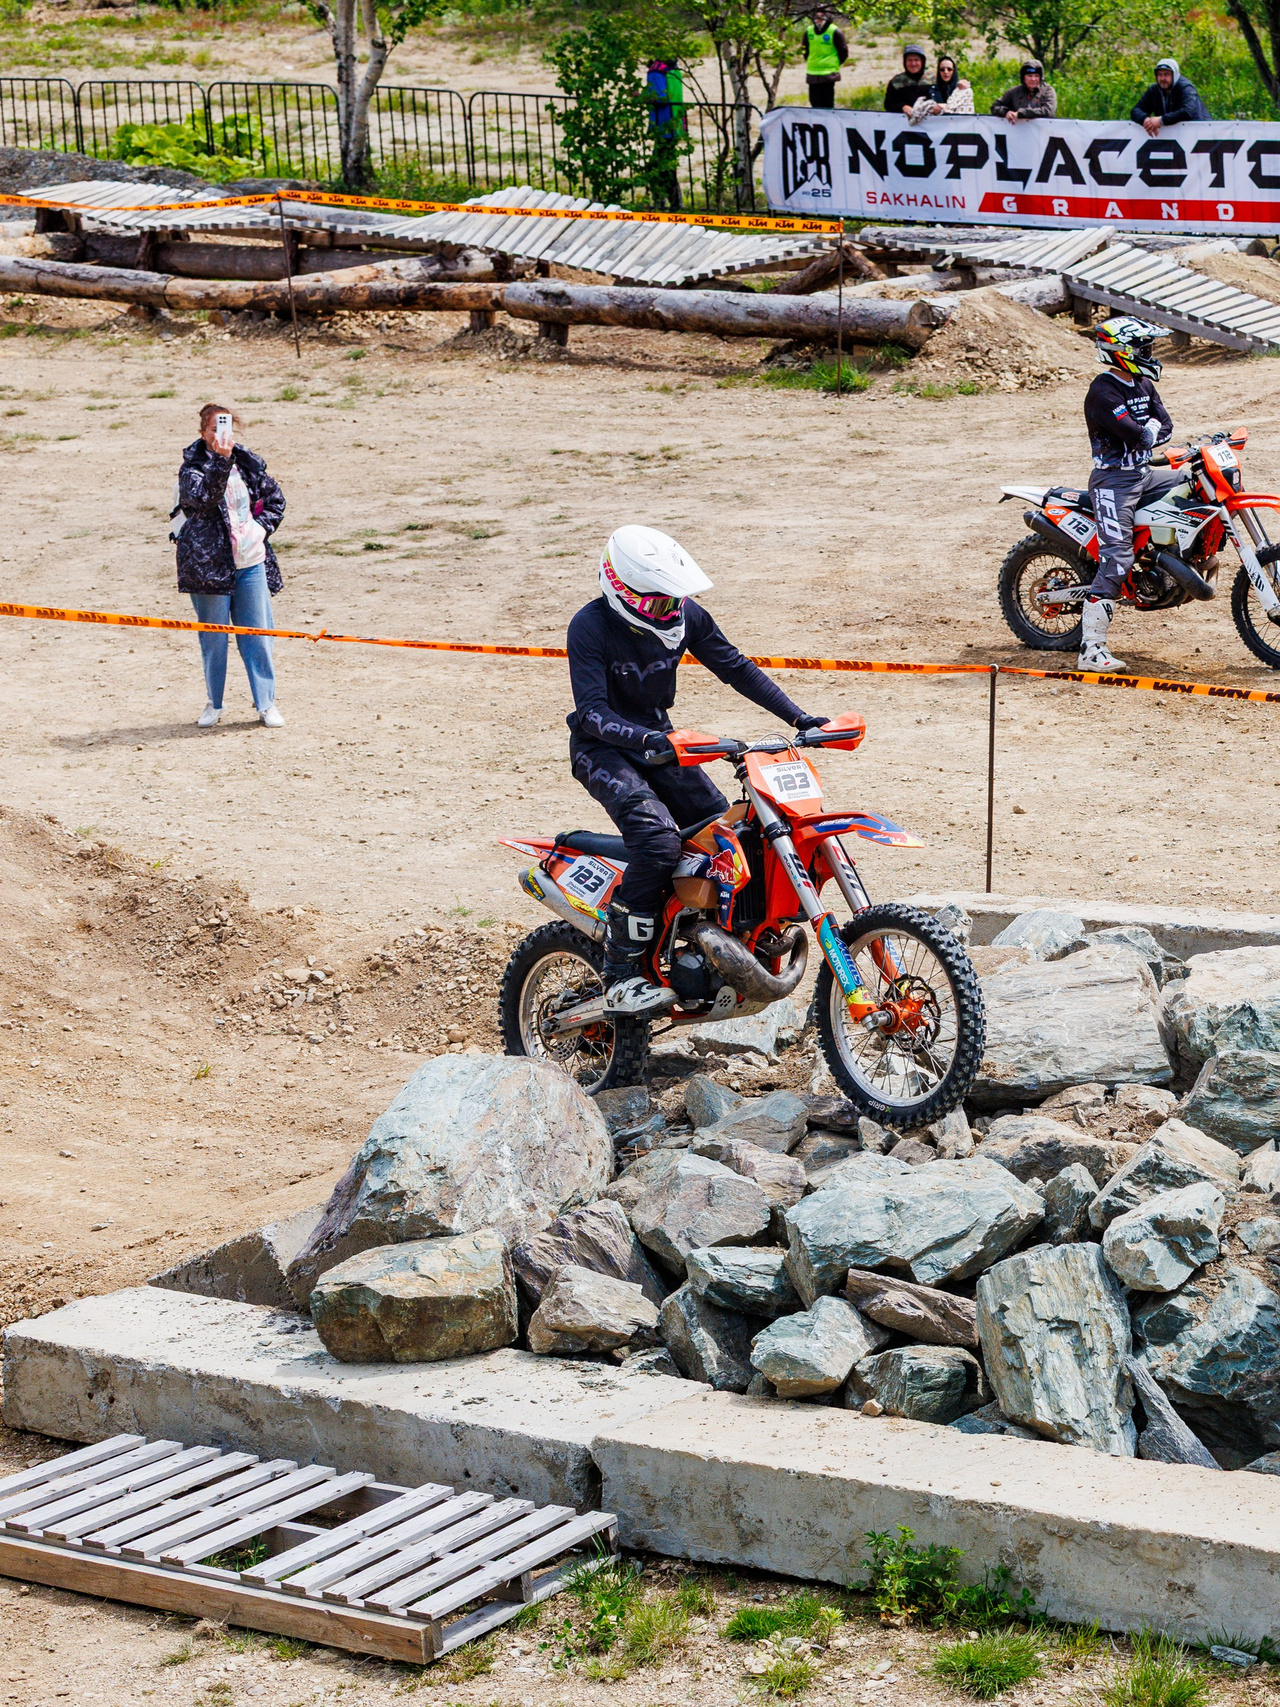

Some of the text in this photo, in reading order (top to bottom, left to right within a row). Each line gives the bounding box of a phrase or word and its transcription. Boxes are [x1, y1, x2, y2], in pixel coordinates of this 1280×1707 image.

[866, 191, 966, 209] SAKHALIN
[1067, 517, 1090, 536] 112
[773, 774, 811, 792] 123
[569, 865, 606, 893] 123
[627, 915, 655, 941] G
[828, 949, 850, 987] MOTOREX
